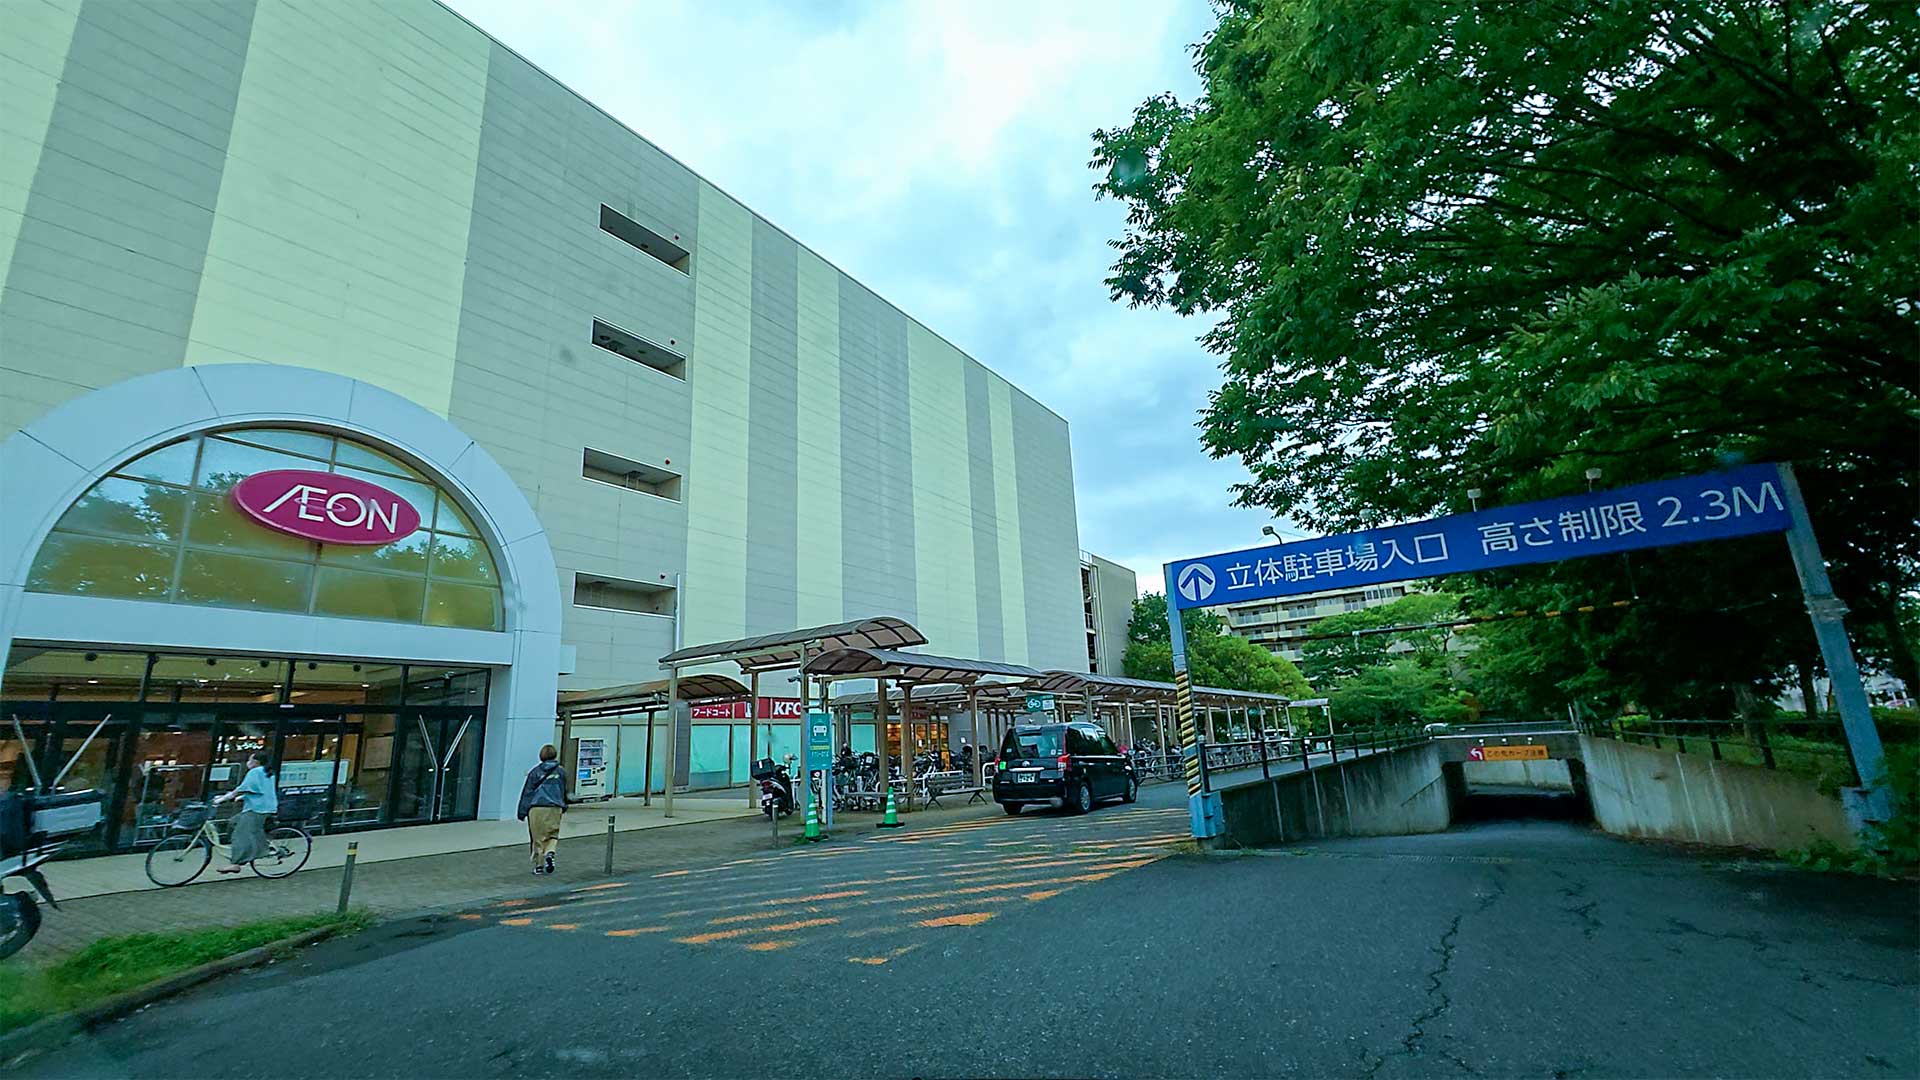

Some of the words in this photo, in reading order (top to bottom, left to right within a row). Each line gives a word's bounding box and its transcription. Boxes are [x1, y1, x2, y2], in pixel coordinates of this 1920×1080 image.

[1226, 532, 1449, 590] 立体駐車場入口
[1477, 501, 1647, 556] 高さ制限
[1657, 481, 1784, 528] 2.3M
[693, 708, 731, 717] フードコート
